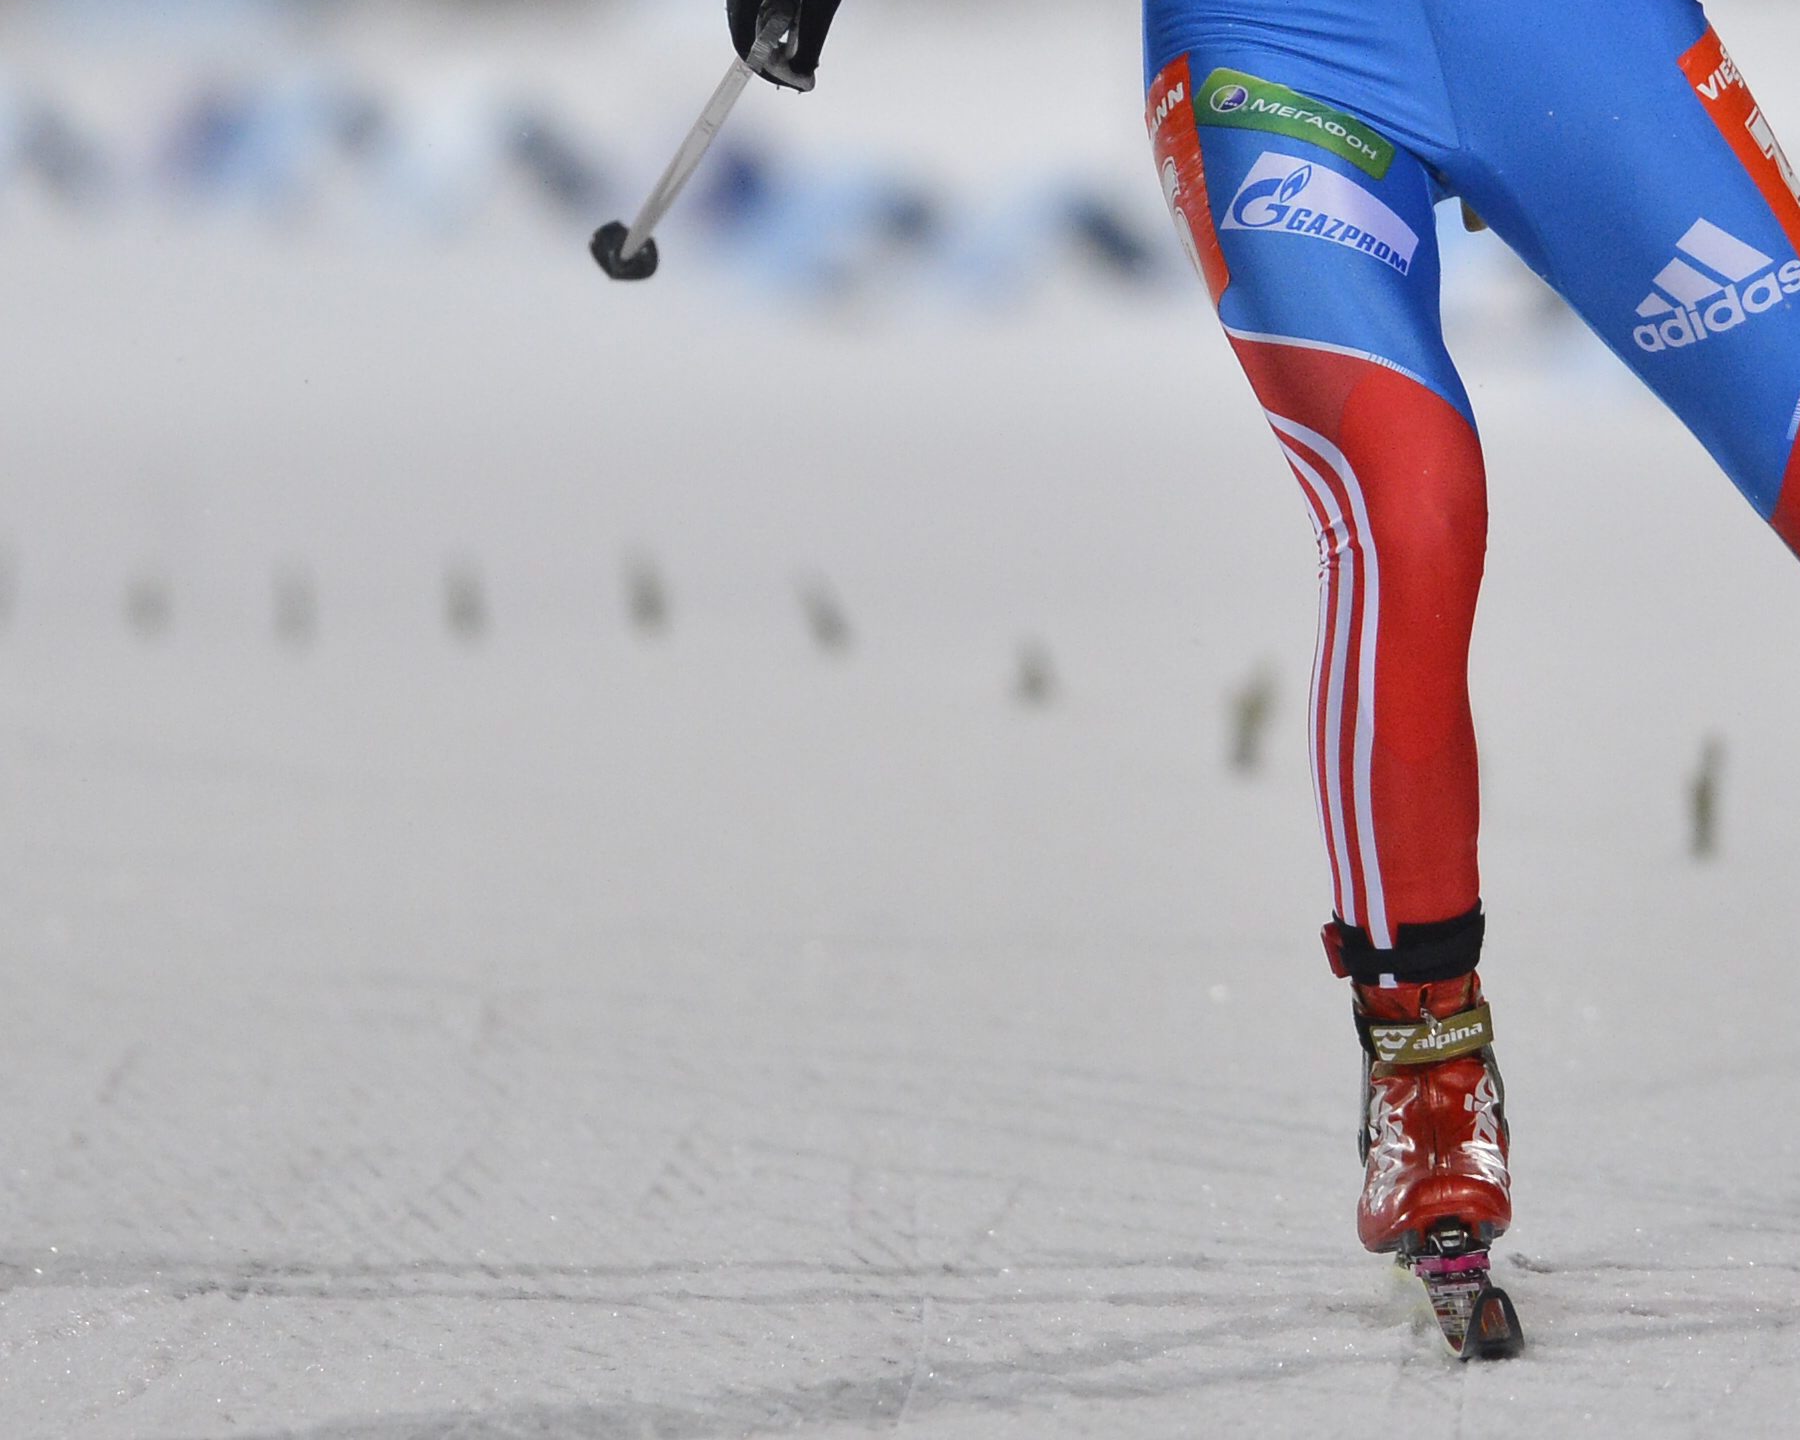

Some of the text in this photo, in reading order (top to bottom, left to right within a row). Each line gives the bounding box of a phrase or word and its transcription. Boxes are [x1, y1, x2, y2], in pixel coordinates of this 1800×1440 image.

[1250, 97, 1378, 161] МЕГАФОН
[1286, 207, 1408, 273] GAZPROM
[1412, 1021, 1483, 1050] alpina
